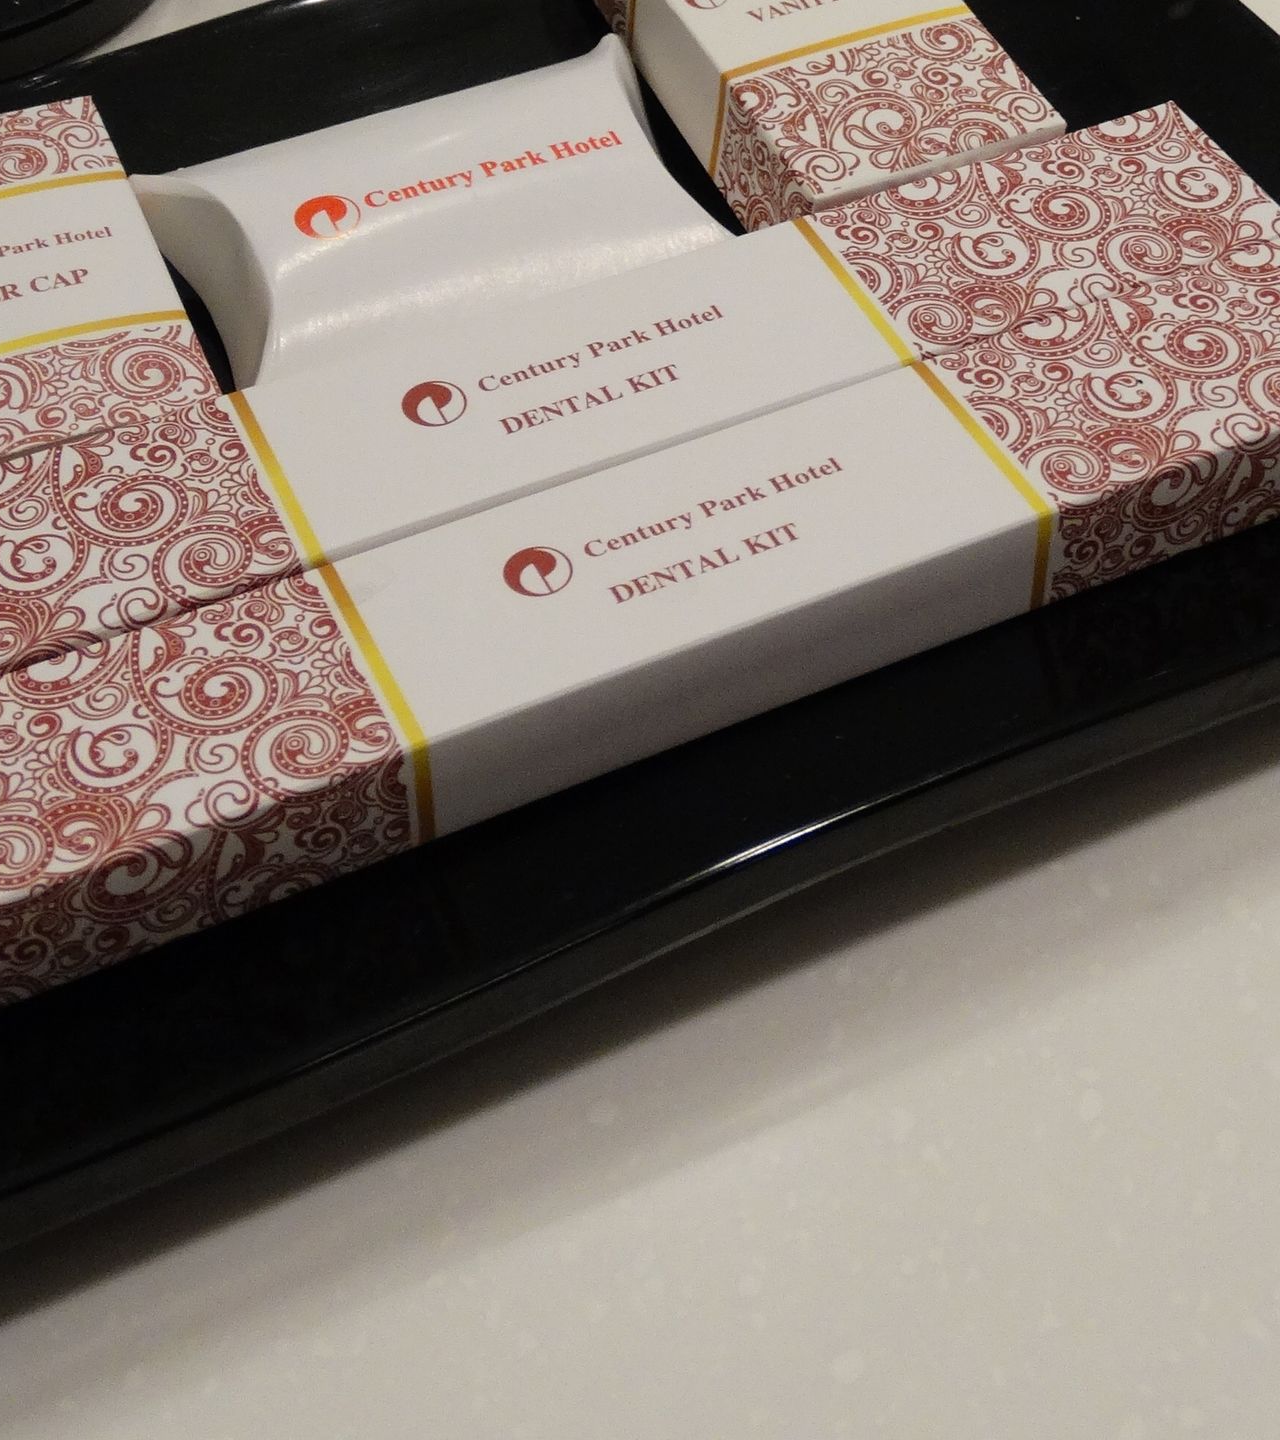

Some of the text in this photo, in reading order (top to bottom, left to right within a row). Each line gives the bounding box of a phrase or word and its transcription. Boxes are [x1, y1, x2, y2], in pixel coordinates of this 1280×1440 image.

[363, 130, 624, 209] Century Park Hotel
[54, 226, 113, 246] Hotel
[29, 268, 89, 293] CAP
[477, 304, 725, 394] Century Park Hotel
[497, 363, 680, 436] DENTAL KIT
[583, 456, 844, 559] Century Park Hotel
[606, 522, 801, 605] DENTAL KIT
